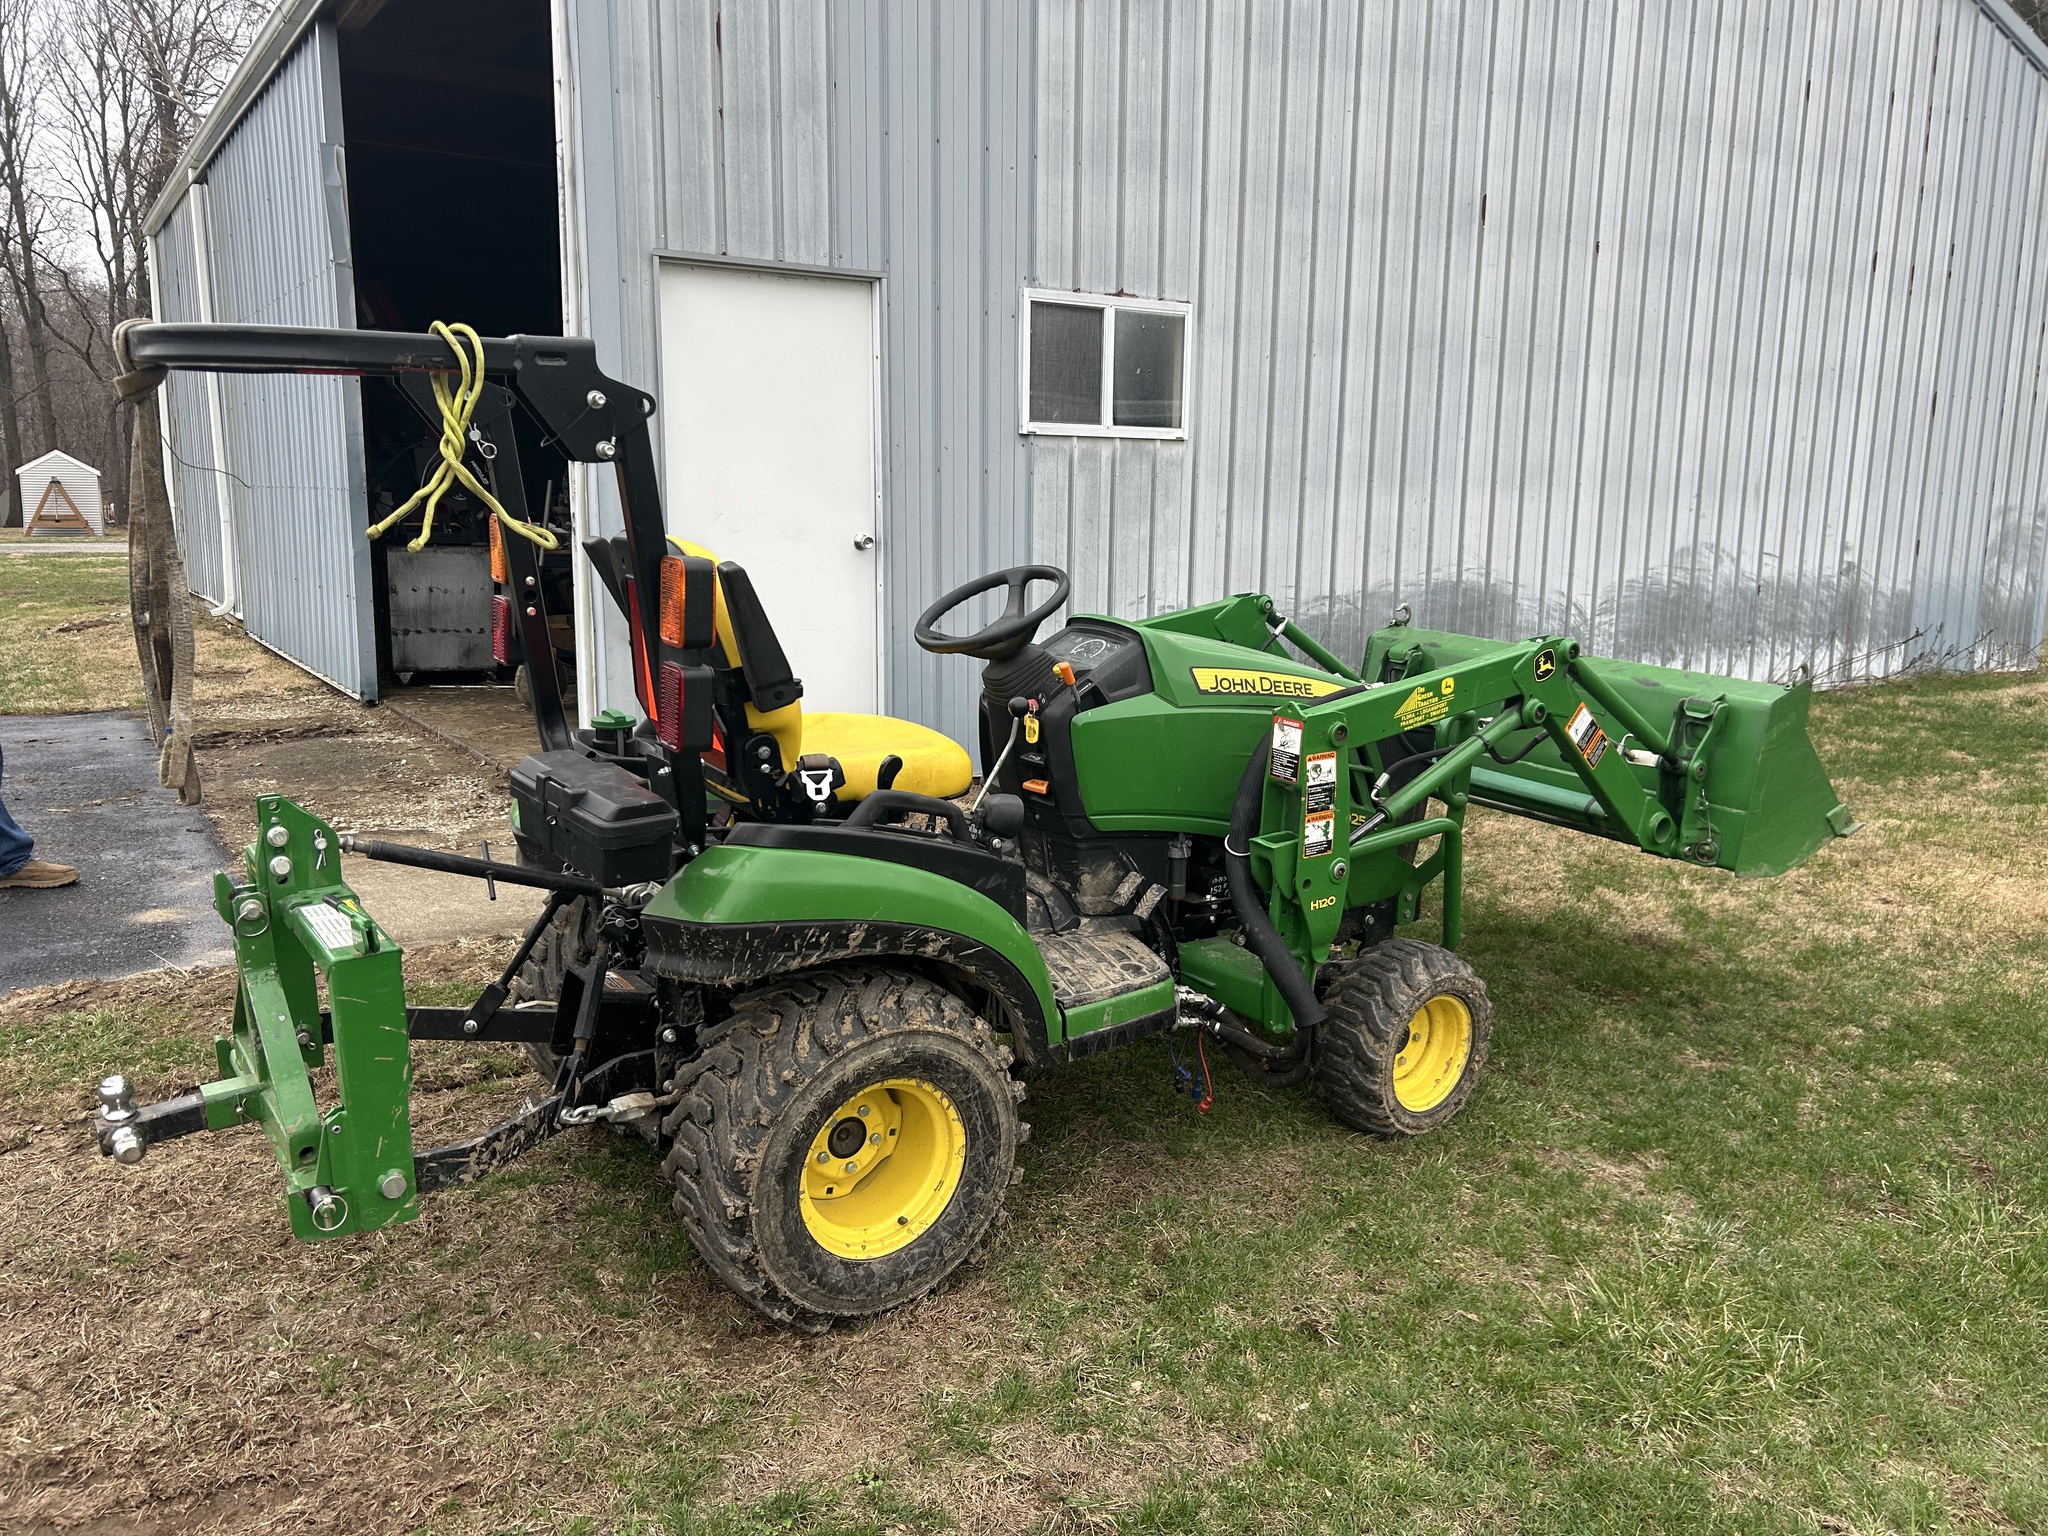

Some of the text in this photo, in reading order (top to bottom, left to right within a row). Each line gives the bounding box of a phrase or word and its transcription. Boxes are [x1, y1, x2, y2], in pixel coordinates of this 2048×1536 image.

[1210, 675, 1314, 695] JOHN DEERE
[1417, 697, 1438, 707] TRACTOR
[1283, 720, 1300, 728] DANGER
[1312, 752, 1335, 760] WARNING
[1310, 813, 1333, 822] WARNING
[1310, 896, 1336, 910] H120
